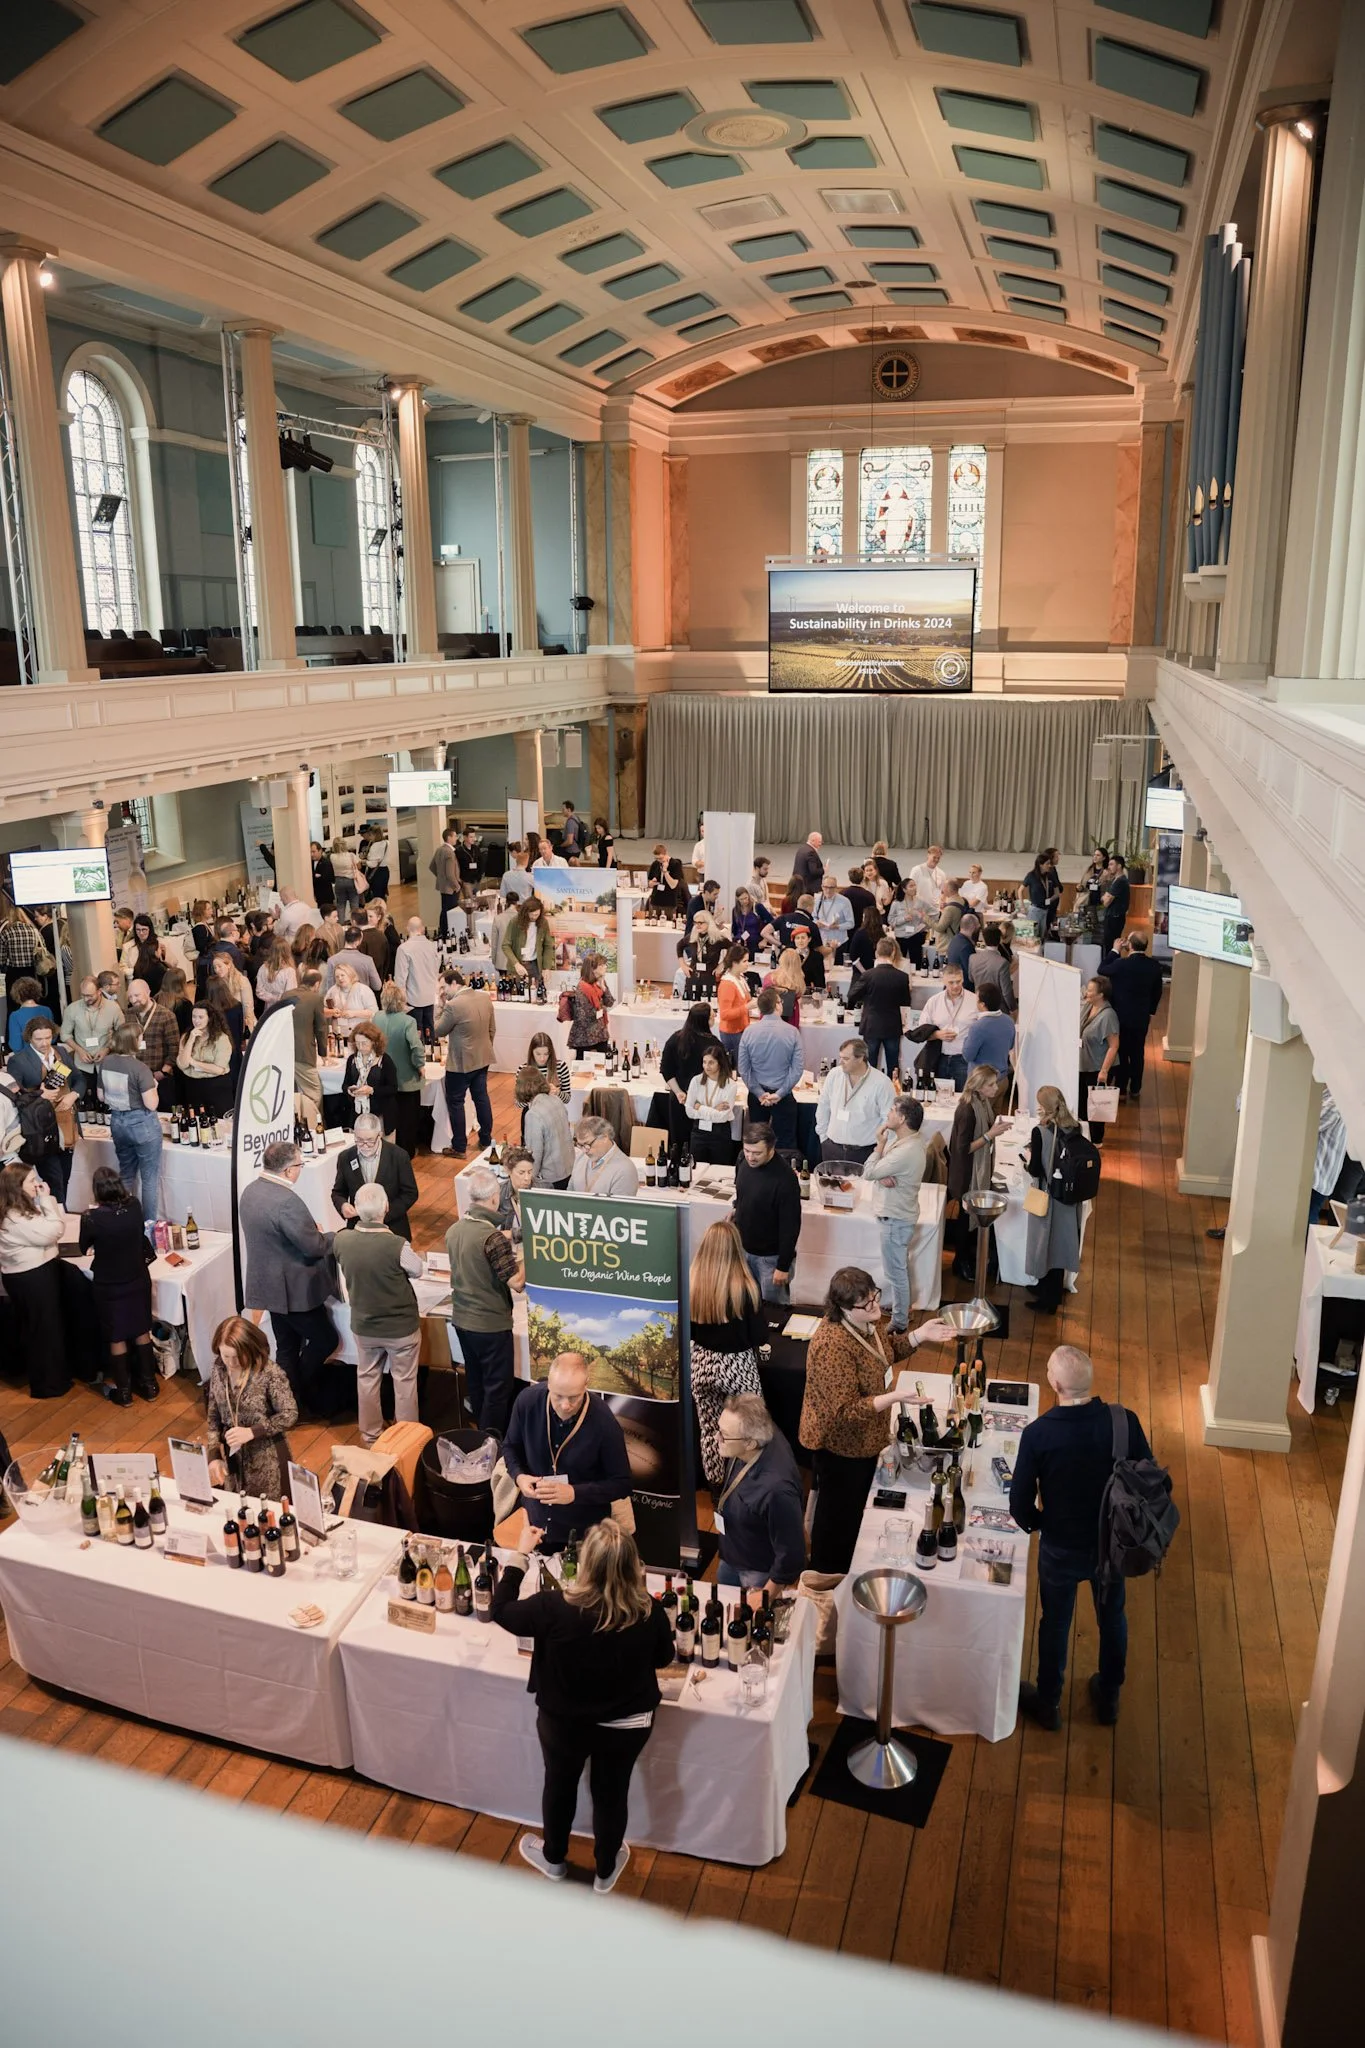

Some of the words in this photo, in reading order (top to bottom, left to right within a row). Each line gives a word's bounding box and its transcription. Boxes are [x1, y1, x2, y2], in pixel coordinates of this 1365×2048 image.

[836, 602, 890, 614] Welcome
[893, 602, 905, 614] to
[789, 617, 867, 631] Sustainability
[869, 617, 881, 629] in
[884, 617, 921, 629] Drinks
[923, 617, 952, 629] 2024
[243, 1124, 290, 1152] Beyond
[525, 1207, 648, 1246] VINTAGE
[531, 1234, 621, 1269] ROOTS
[561, 1267, 578, 1279] The
[580, 1268, 614, 1281] Organic
[615, 1270, 641, 1282] Wine
[642, 1271, 672, 1286] People
[641, 1495, 673, 1508] Organic
